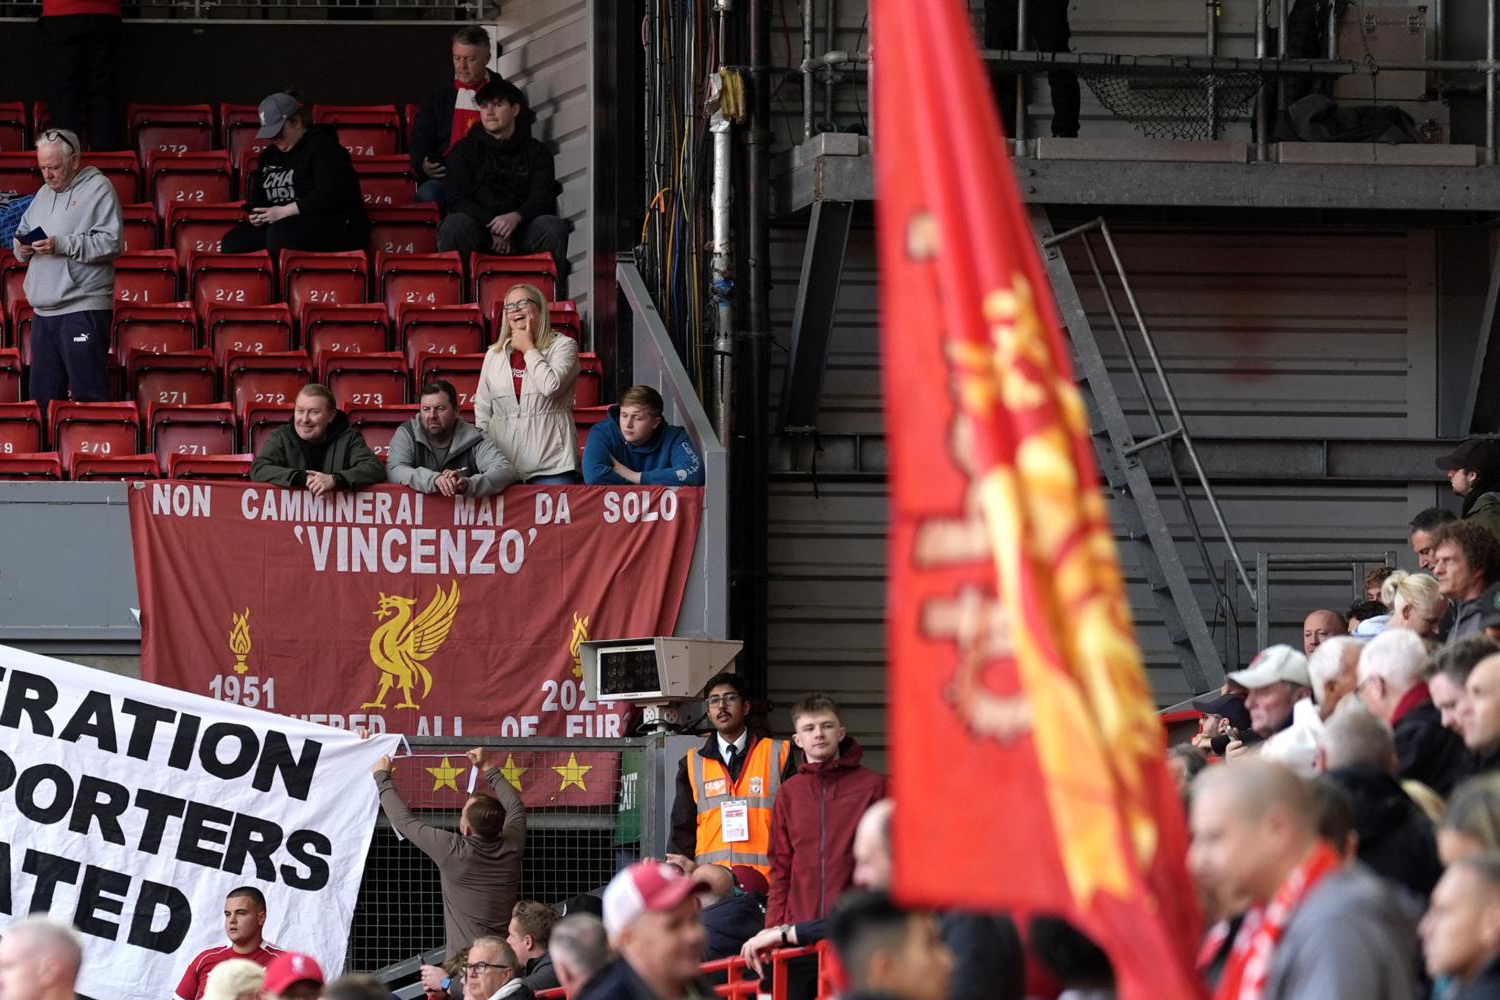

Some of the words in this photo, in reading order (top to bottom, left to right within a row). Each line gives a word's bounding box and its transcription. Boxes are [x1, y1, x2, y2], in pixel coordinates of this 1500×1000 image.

[263, 169, 294, 188] CHA
[160, 392, 187, 404] 271
[256, 394, 285, 405] 272
[353, 394, 383, 407] 273
[459, 394, 475, 405] 74
[180, 445, 207, 456] 271
[152, 486, 211, 516] NON
[241, 488, 423, 526] CAMMINERAI
[454, 492, 504, 526] MAI
[535, 492, 572, 525] DA
[603, 488, 678, 523] SOLO
[209, 674, 276, 709] 1951
[619, 772, 638, 812] XIT
